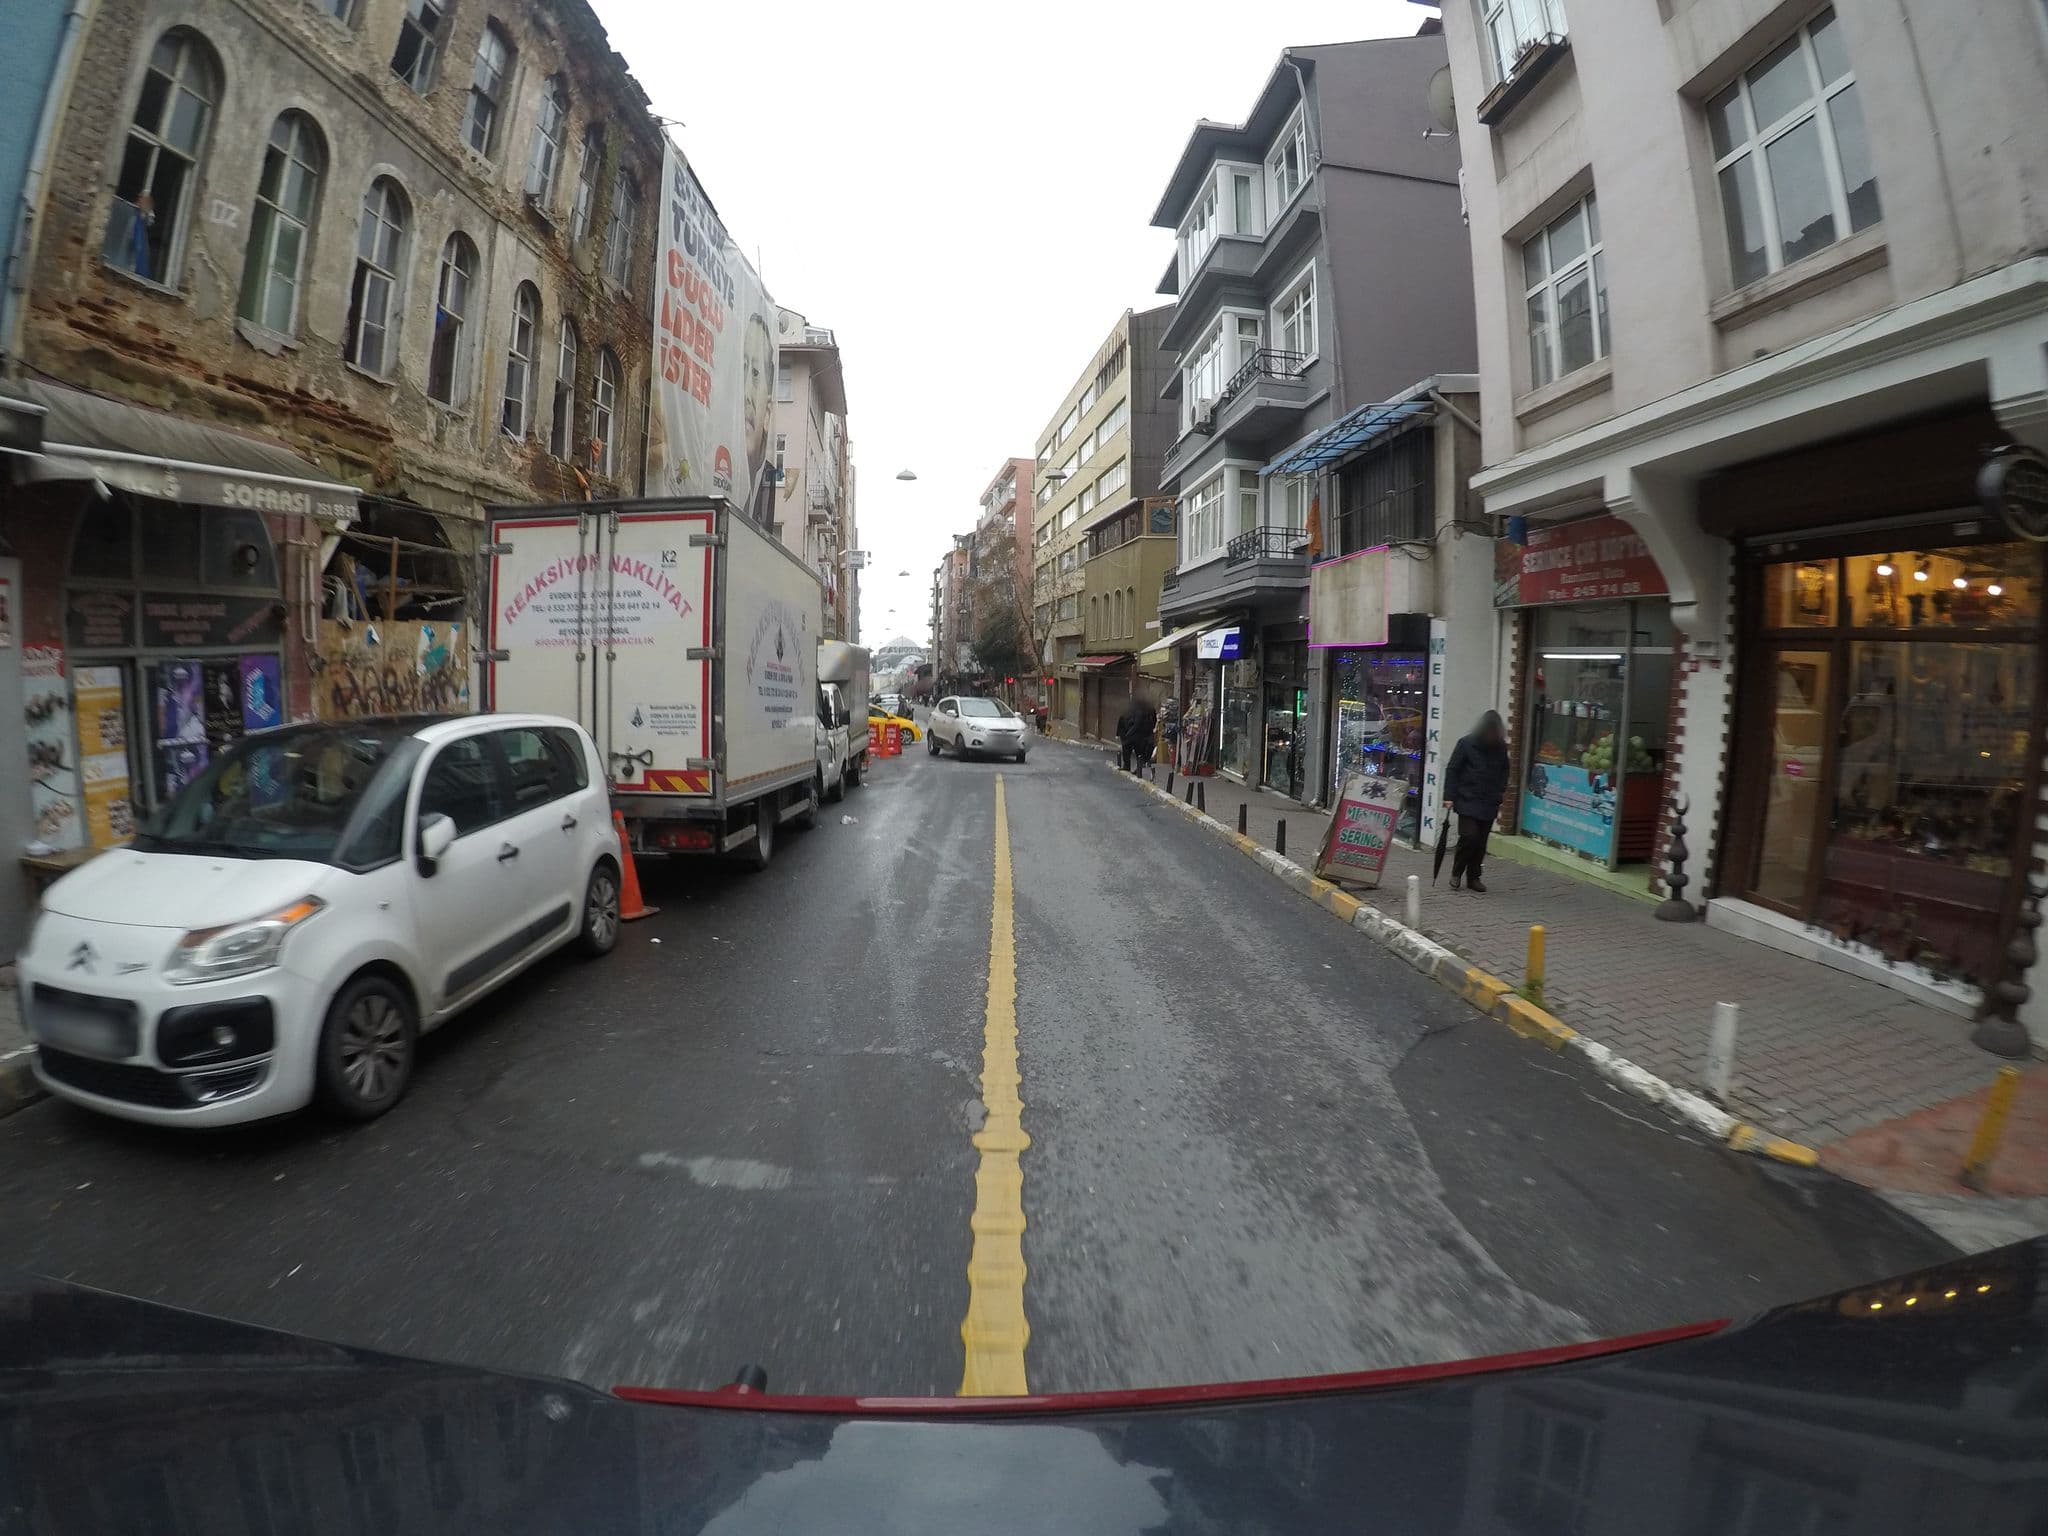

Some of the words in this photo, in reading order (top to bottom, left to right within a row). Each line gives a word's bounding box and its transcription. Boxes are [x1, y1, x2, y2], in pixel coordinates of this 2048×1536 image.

[667, 248, 725, 333] GÜÇLÜ
[672, 199, 735, 310] TÜRKİYE
[660, 288, 715, 369] LİDER
[660, 335, 712, 409] İSTER
[504, 552, 601, 625] REAKSİYON
[609, 554, 693, 619] NAKLİYAT
[662, 550, 677, 563] K2
